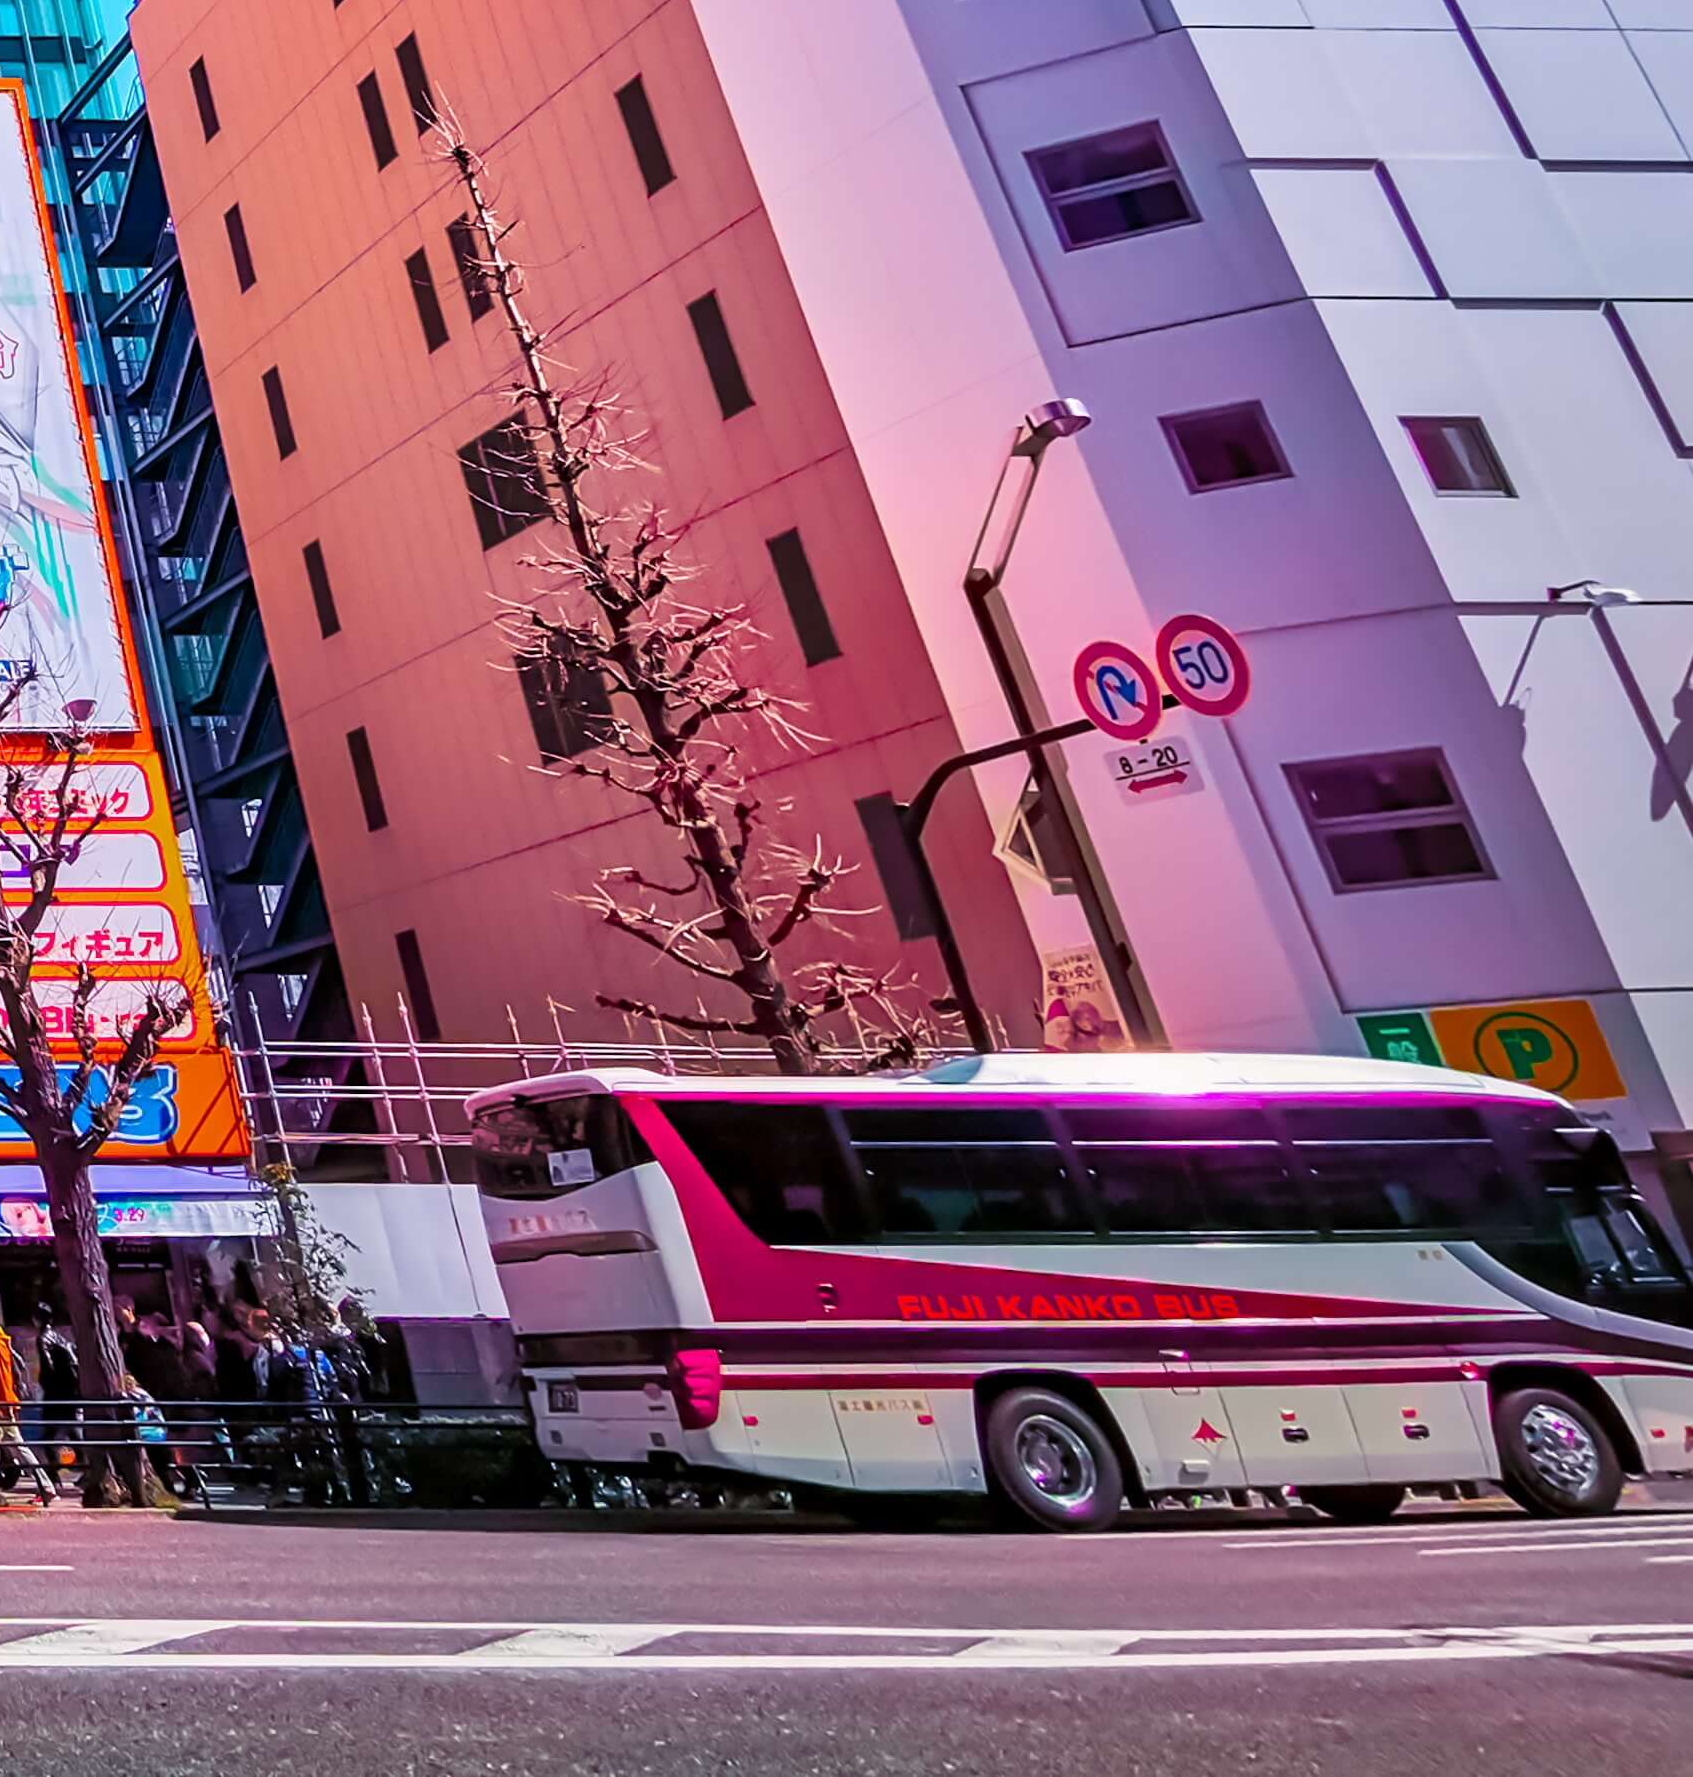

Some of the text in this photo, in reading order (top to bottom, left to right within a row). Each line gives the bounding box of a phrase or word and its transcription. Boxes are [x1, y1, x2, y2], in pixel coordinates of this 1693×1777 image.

[1172, 641, 1229, 690] 50
[1495, 1027, 1553, 1081] P
[897, 1294, 1239, 1320] FUJI KANKO BUS
